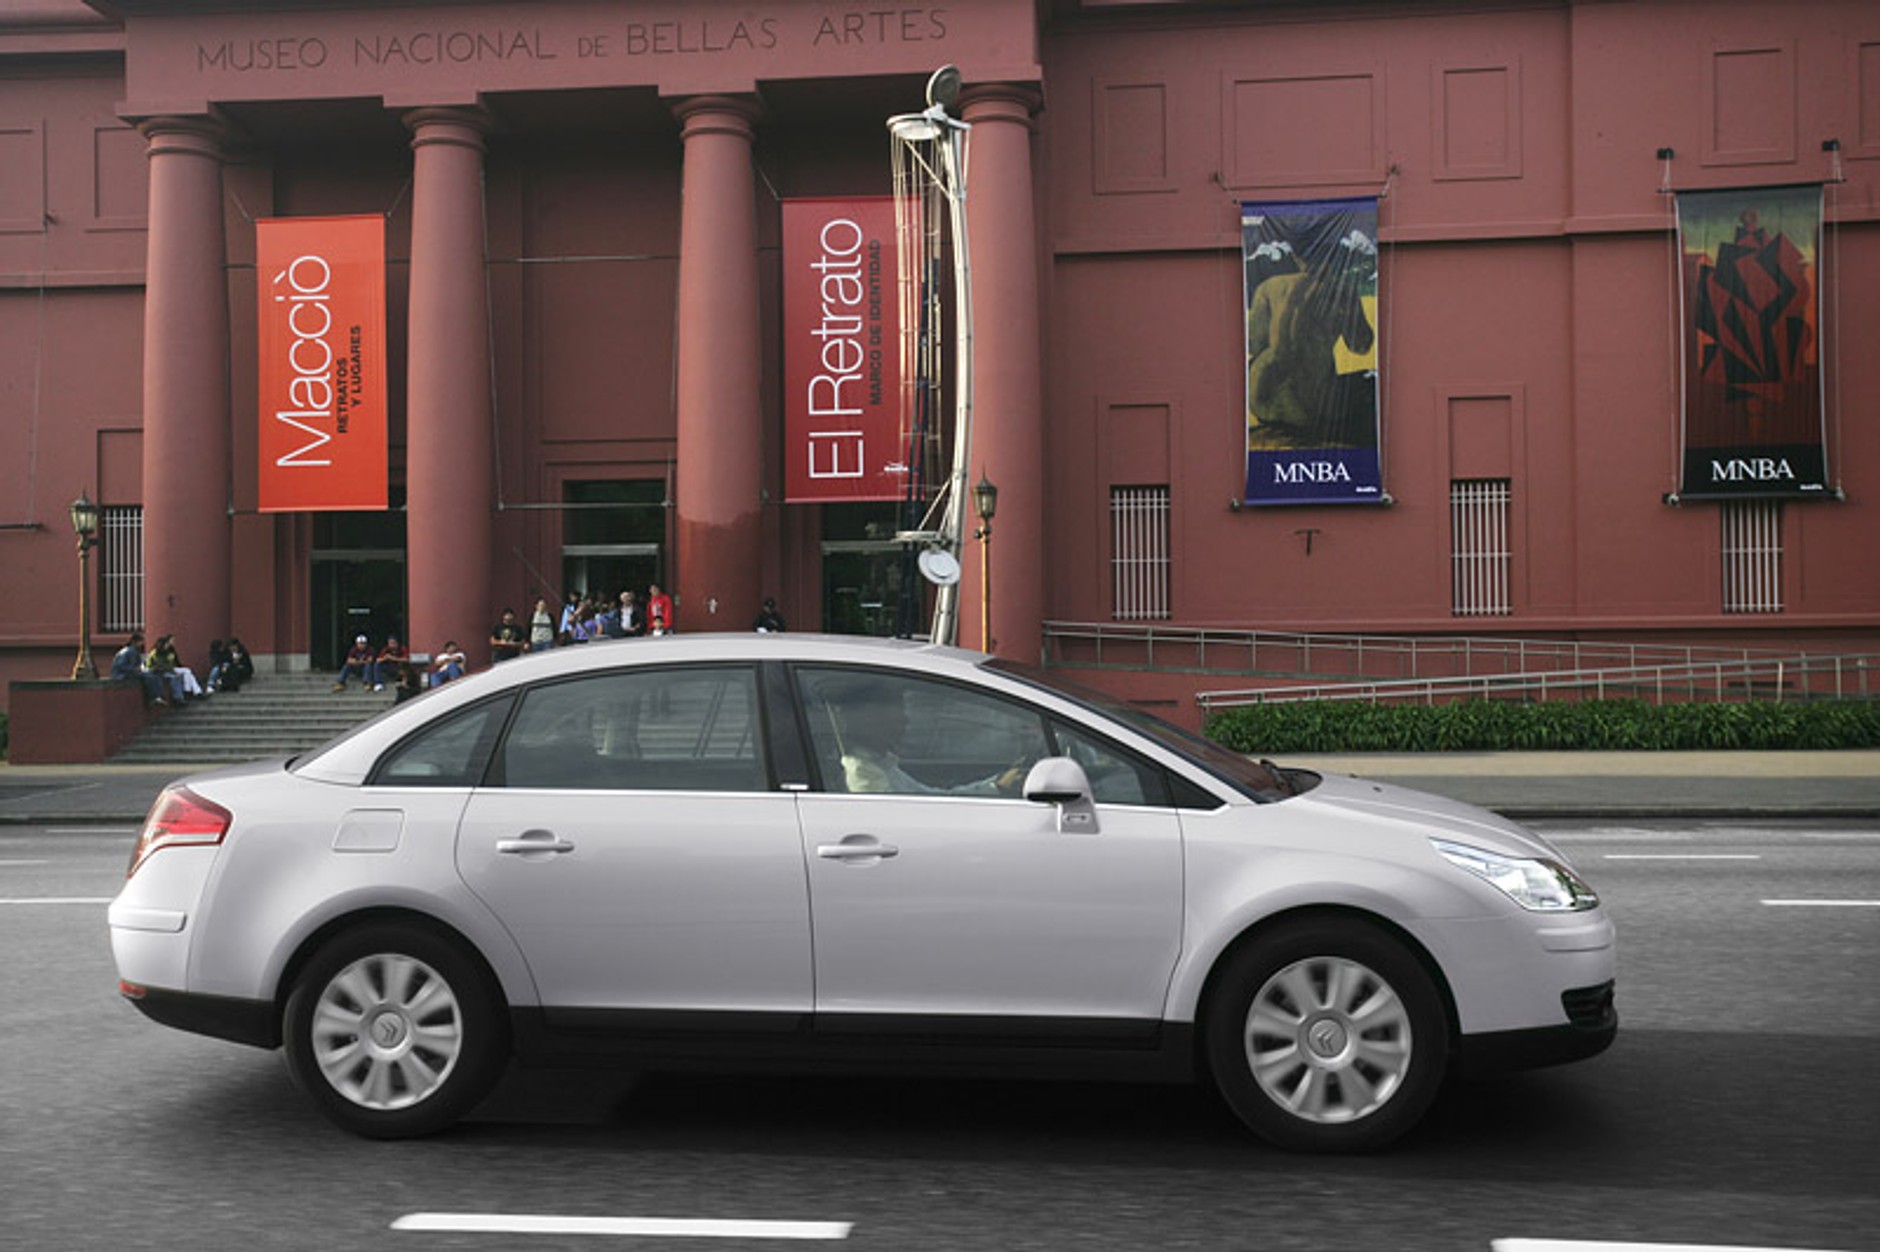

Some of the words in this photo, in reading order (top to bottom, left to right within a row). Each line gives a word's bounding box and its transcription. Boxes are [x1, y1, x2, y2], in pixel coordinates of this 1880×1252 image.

[197, 37, 327, 72] MUSEO
[354, 30, 557, 65] NACIONAL
[578, 36, 608, 58] DE
[627, 19, 777, 56] BELLAS
[813, 10, 947, 46] ARTES
[868, 239, 881, 320] IDENTIDAD
[808, 218, 864, 415] Retrato
[869, 325, 882, 347] DE
[273, 255, 332, 466] Macciò
[350, 325, 362, 394] LUGARES
[869, 350, 882, 405] MARCO
[336, 357, 349, 434] RETRATOS
[350, 398, 362, 408] Y
[808, 431, 864, 479] El
[1274, 461, 1351, 483] MNBA
[1711, 458, 1795, 481] MNBA
